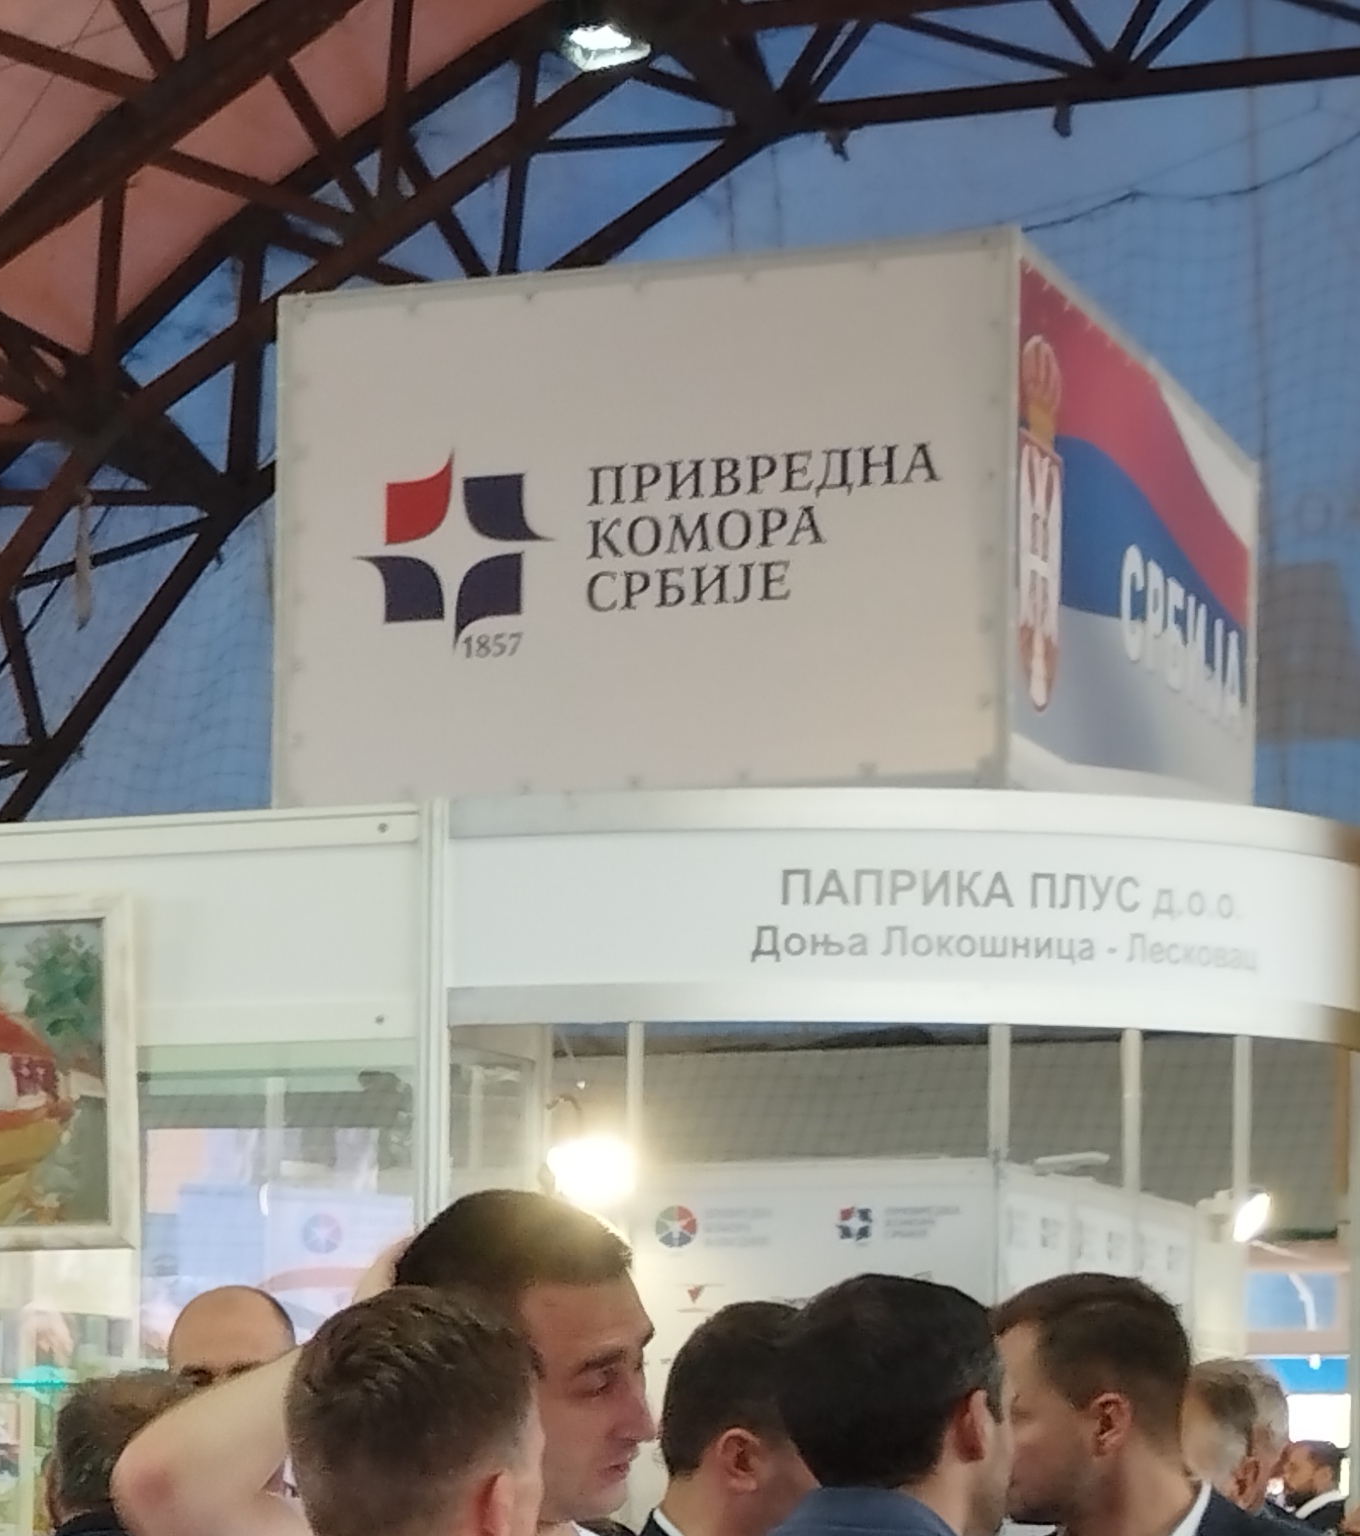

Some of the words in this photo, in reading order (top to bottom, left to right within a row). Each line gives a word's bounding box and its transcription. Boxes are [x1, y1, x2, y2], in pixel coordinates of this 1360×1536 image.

[586, 441, 942, 506] ПРИВРЕДНА
[585, 504, 827, 560] КОМОРА
[585, 560, 792, 613] СРБИЈЕ
[461, 631, 524, 659] 1857
[780, 867, 1016, 909] ПАПРИКА
[1030, 873, 1142, 913] ПЛУС
[750, 925, 870, 963] Доња
[880, 924, 1097, 966] Локошница
